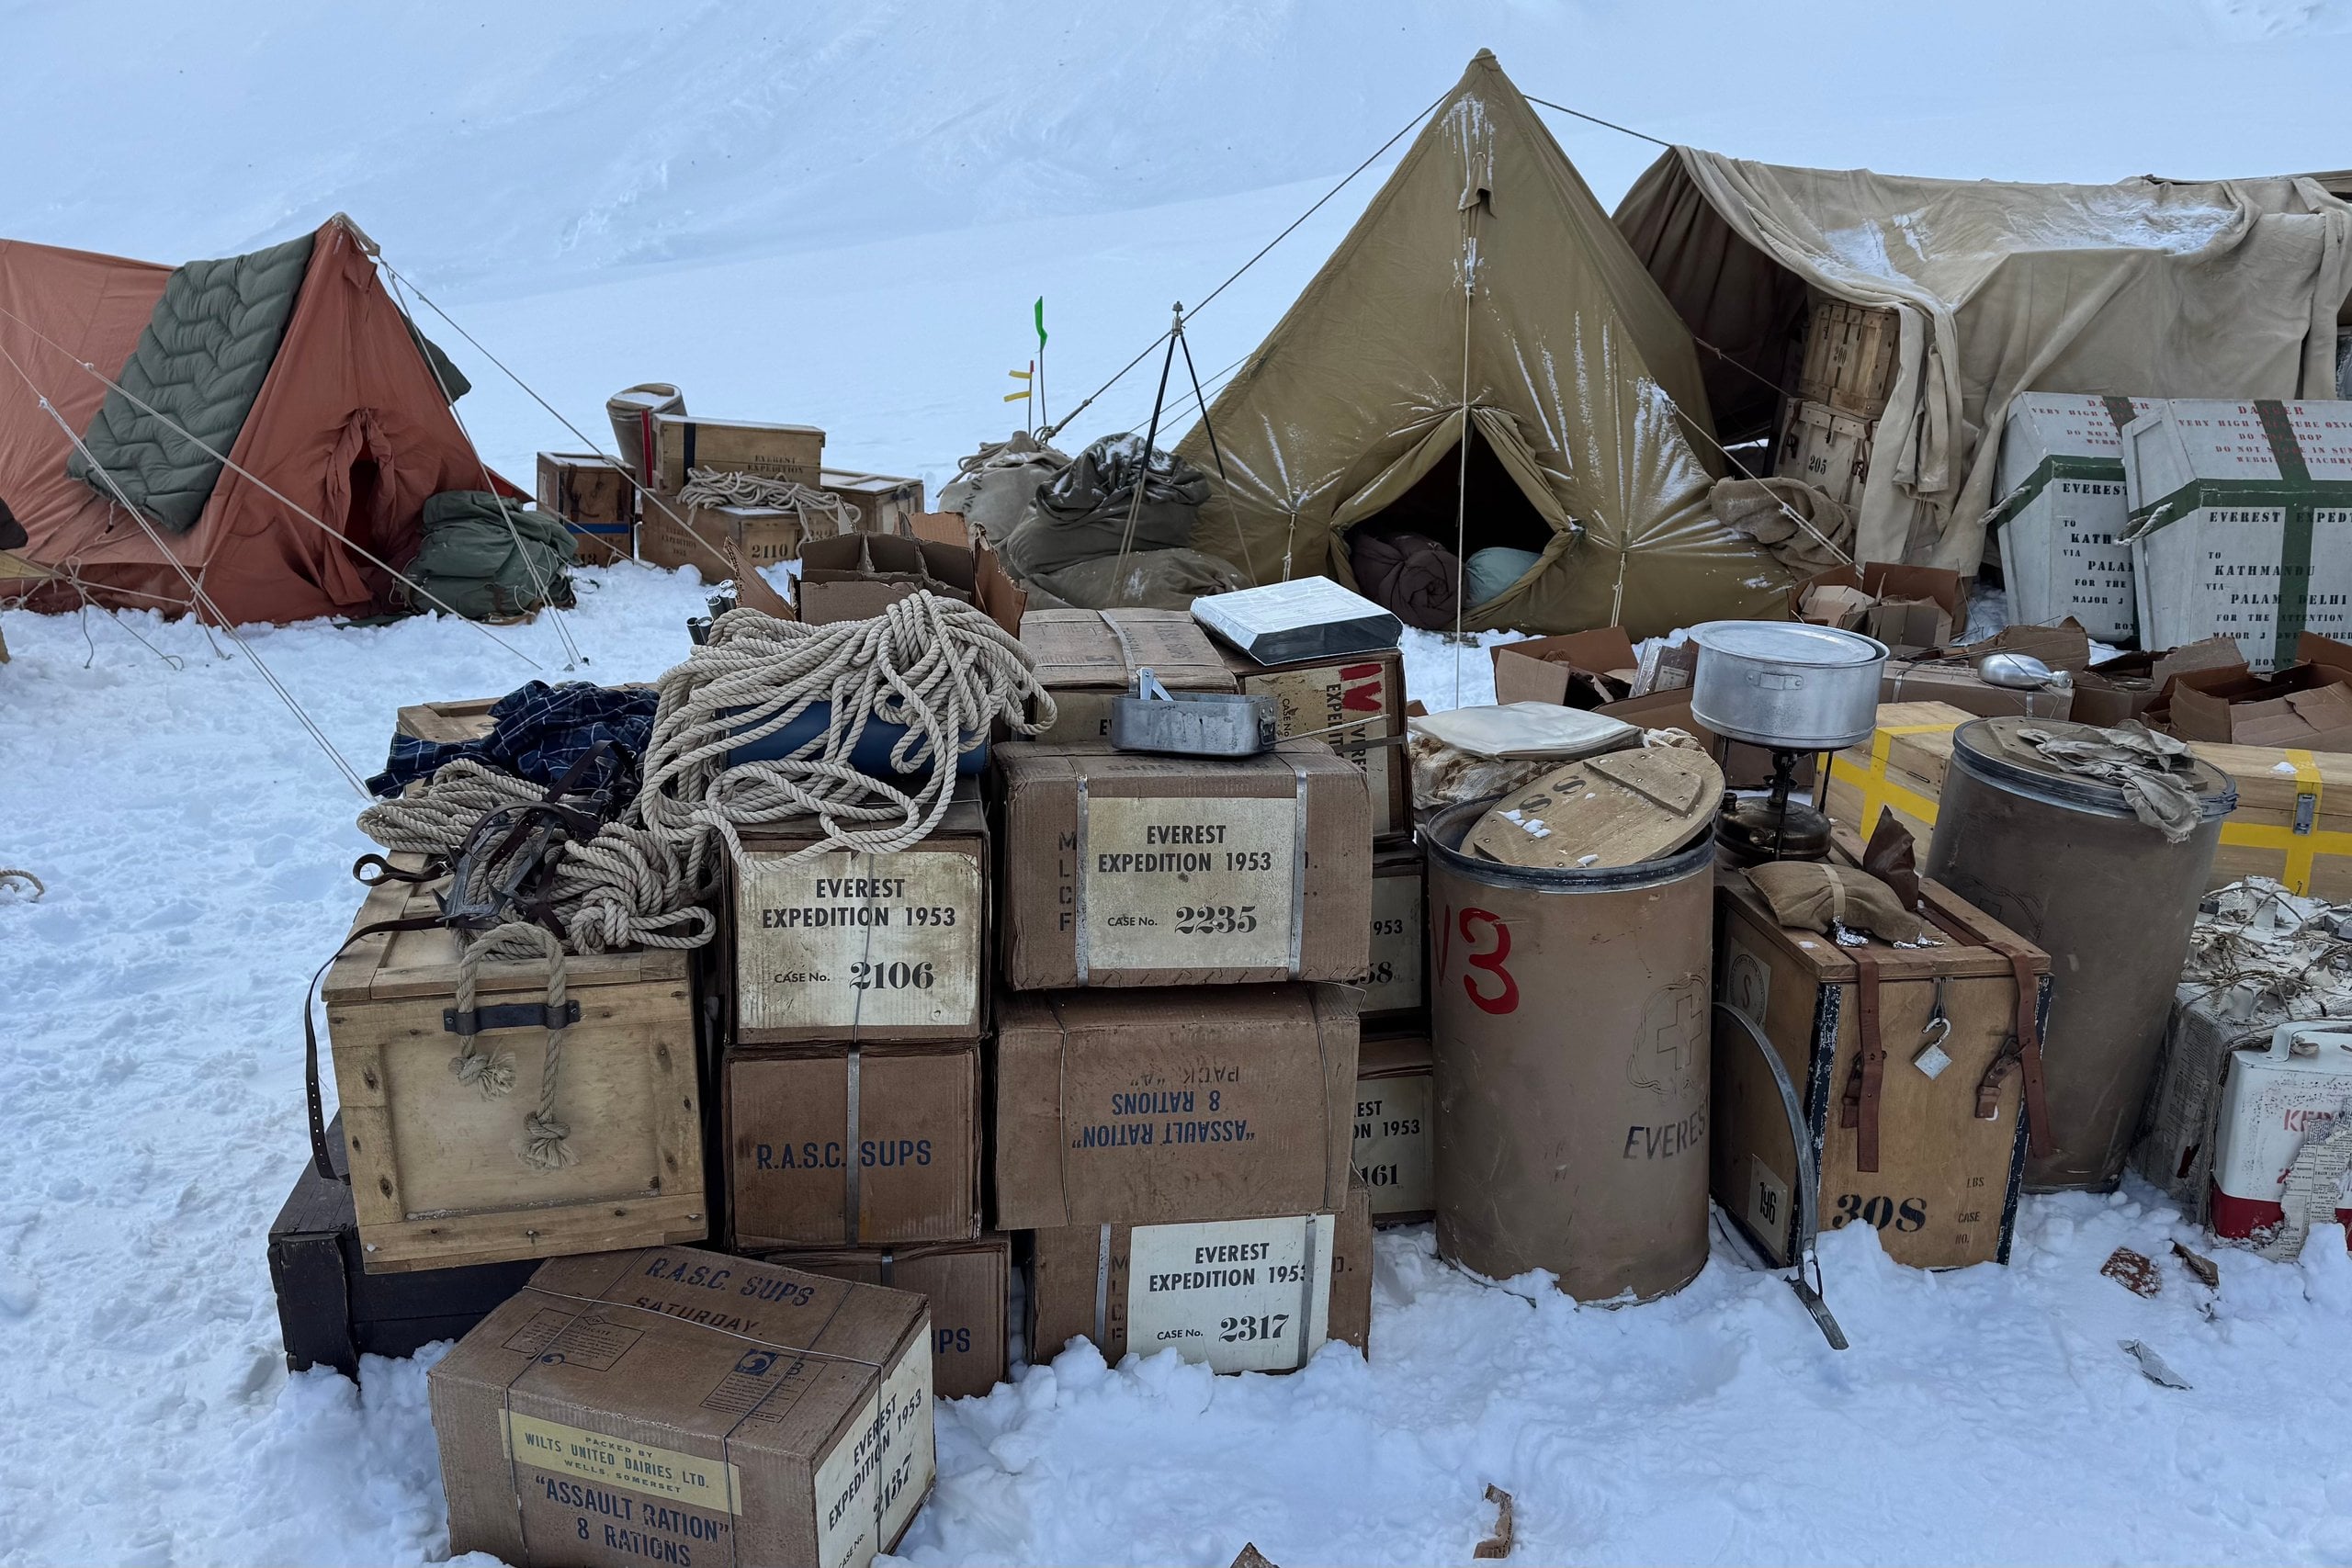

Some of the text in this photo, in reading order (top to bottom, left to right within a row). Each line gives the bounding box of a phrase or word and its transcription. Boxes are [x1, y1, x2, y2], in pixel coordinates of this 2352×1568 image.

[2087, 400, 2150, 410] DANGER
[2238, 406, 2304, 415] DANGER
[2178, 419, 2210, 427] VERY
[748, 465, 803, 474] EXPEDITION
[1808, 456, 1827, 475] 205
[2210, 512, 2280, 523] EVEREST
[2071, 534, 2112, 544] KATH
[752, 543, 788, 558] 2110
[2214, 565, 2315, 576] KATHMANDU
[2075, 579, 2127, 588] FOR THE
[2073, 595, 2109, 604] MAJOR
[2231, 594, 2346, 605] PALAM DELHI
[2256, 659, 2277, 667] BOX
[1283, 698, 1291, 721] CASE
[1147, 825, 1227, 844] EVEREST
[1098, 852, 1272, 873] EXPEDITION 1953
[816, 878, 905, 898] EVEREST
[763, 906, 956, 929] EXPEDITION 1953
[1107, 906, 1257, 935] CASE No. 2235
[1374, 919, 1403, 935] 953
[774, 961, 934, 990] CASE No. 2106
[1182, 1066, 1240, 1084] PACK
[1112, 1090, 1221, 1116] 8 RATIONS
[1354, 1100, 1383, 1118] EST
[1383, 1120, 1420, 1137] 1953
[1623, 1102, 1707, 1160] EVERES
[757, 1139, 932, 1169] R.A.S.C. SUPS
[1966, 1177, 1984, 1188] LBS
[1759, 1182, 1777, 1225] 196
[1958, 1212, 1981, 1224] CASE
[1195, 1243, 1270, 1264] EVEREST
[645, 1258, 815, 1306] R.A.S.C. SUPS
[1149, 1268, 1255, 1292] EXPEDITION
[1157, 1314, 1289, 1343] CASE No. 2317
[854, 1393, 898, 1467] EVEREST
[585, 1437, 653, 1459] PACKED BY
[525, 1433, 709, 1488] WILTS UNITED DAIRIES LTD.
[829, 1388, 922, 1531] EXPEDITION 1953
[616, 1472, 681, 1493] SOMERSET
[577, 1517, 691, 1567] 8 RATIONS
